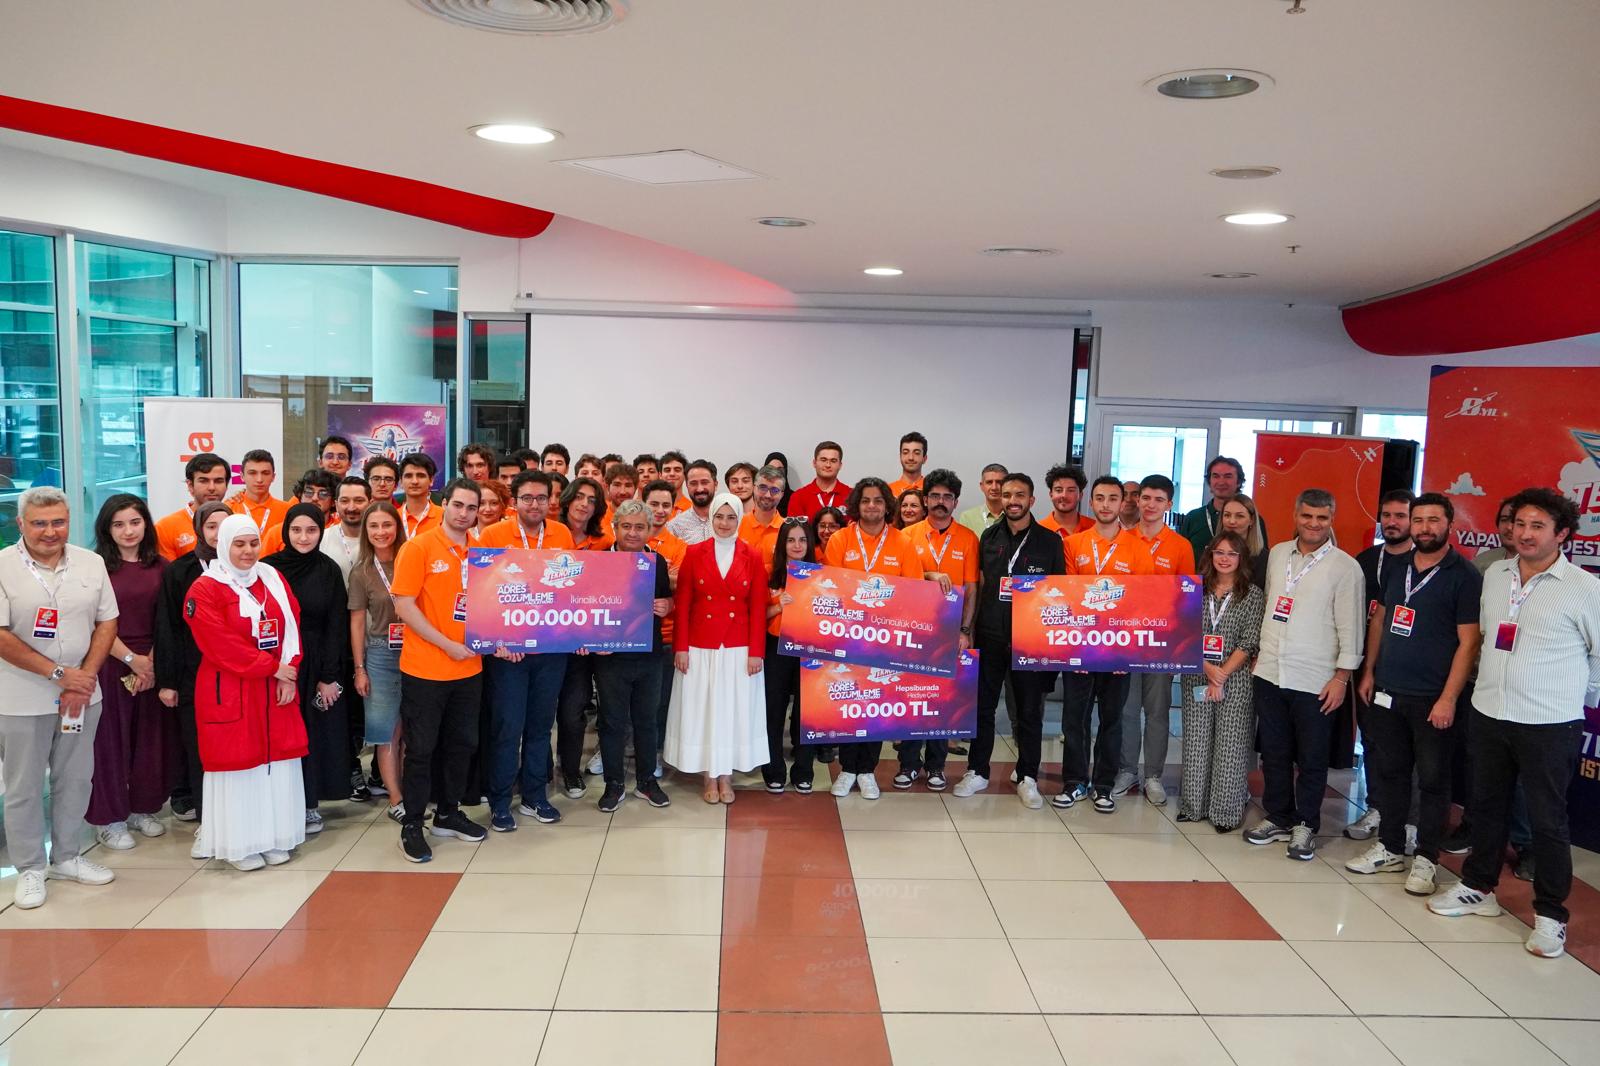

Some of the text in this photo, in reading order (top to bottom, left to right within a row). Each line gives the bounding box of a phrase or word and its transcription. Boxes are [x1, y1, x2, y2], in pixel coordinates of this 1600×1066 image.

[497, 584, 527, 595] ADRES
[812, 598, 840, 608] ADRES
[501, 608, 622, 626] 100.000 TL.
[1040, 608, 1069, 618] ADRES
[818, 619, 923, 649] 90.000 TL.
[1045, 629, 1167, 647] 120.000 TL.
[828, 682, 856, 692] ADRES
[895, 684, 940, 693] Hepsiburada
[839, 701, 939, 719] 10.000 TL.
